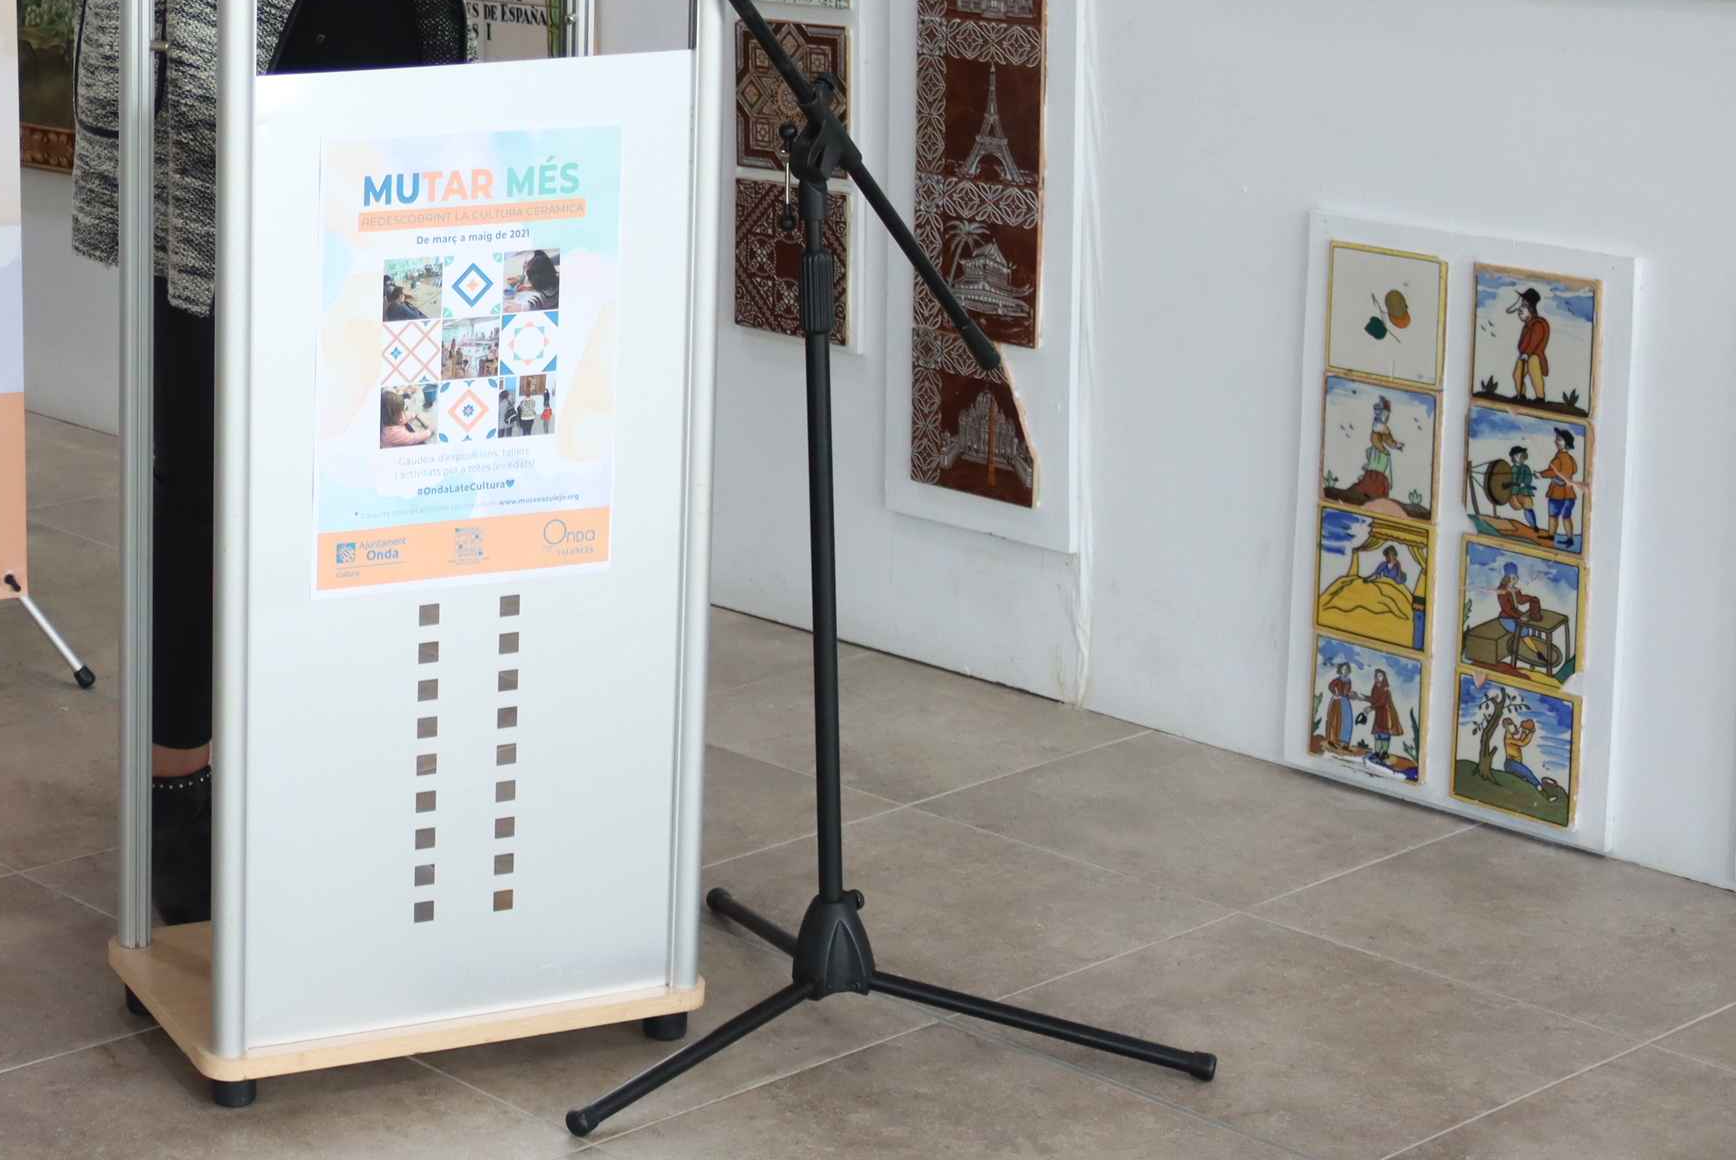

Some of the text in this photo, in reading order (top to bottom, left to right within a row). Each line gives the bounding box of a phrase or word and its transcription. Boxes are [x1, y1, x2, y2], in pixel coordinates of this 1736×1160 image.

[483, 3, 498, 21] DE
[500, 3, 549, 27] ESPAÑA
[363, 155, 581, 207] MUTAR MÉS
[361, 202, 585, 228] REDESCOBRINT LA CULTURA CERÀMICA
[416, 228, 531, 245] De març a maig de 2021
[398, 453, 436, 467] Gaudeix
[501, 446, 530, 457] tallers
[399, 466, 441, 480] activitats
[442, 466, 459, 477] per
[468, 462, 492, 474] totes
[416, 480, 507, 497] #OndaLateCultura
[498, 492, 580, 508] www.museoazulejo.org
[358, 536, 407, 551] Ajuntament
[365, 547, 400, 561] Onda
